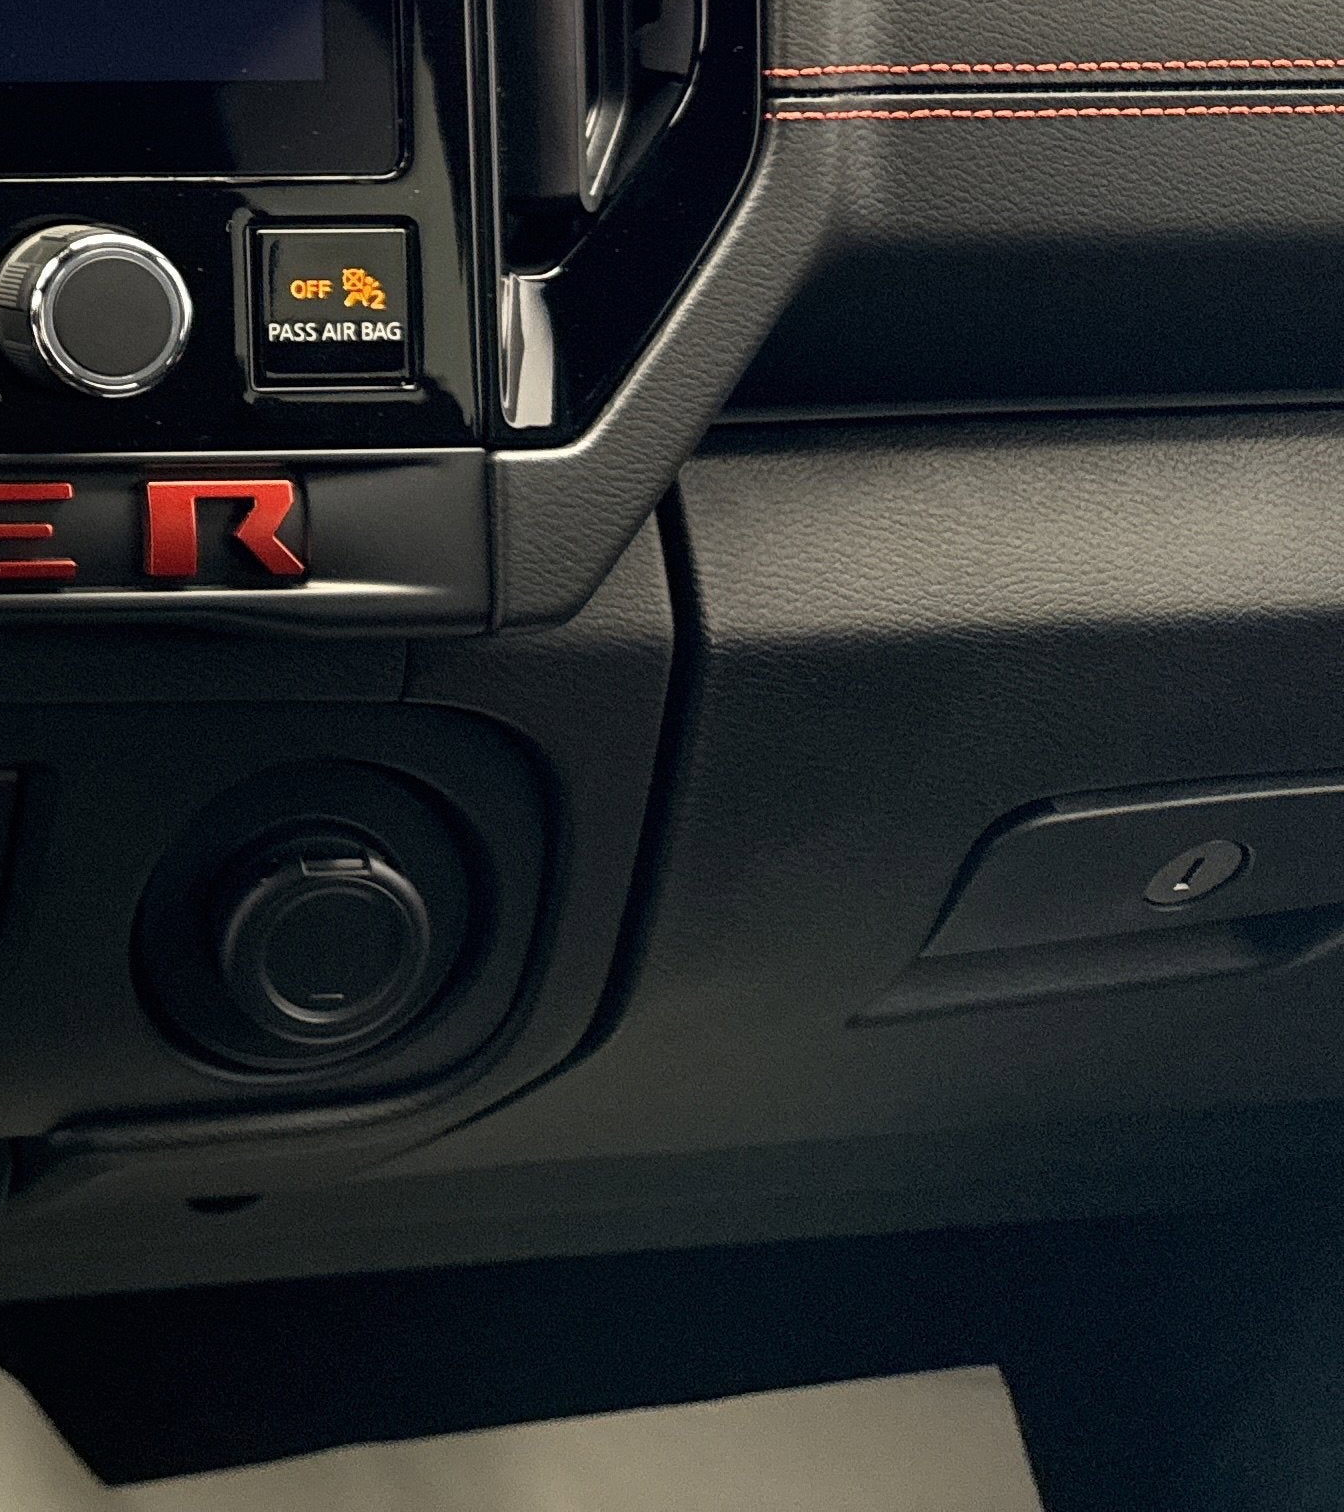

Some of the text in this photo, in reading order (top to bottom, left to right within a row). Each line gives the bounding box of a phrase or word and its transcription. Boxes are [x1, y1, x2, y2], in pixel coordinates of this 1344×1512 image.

[289, 279, 334, 300] OFF
[267, 320, 402, 342] PASS AIR BAG
